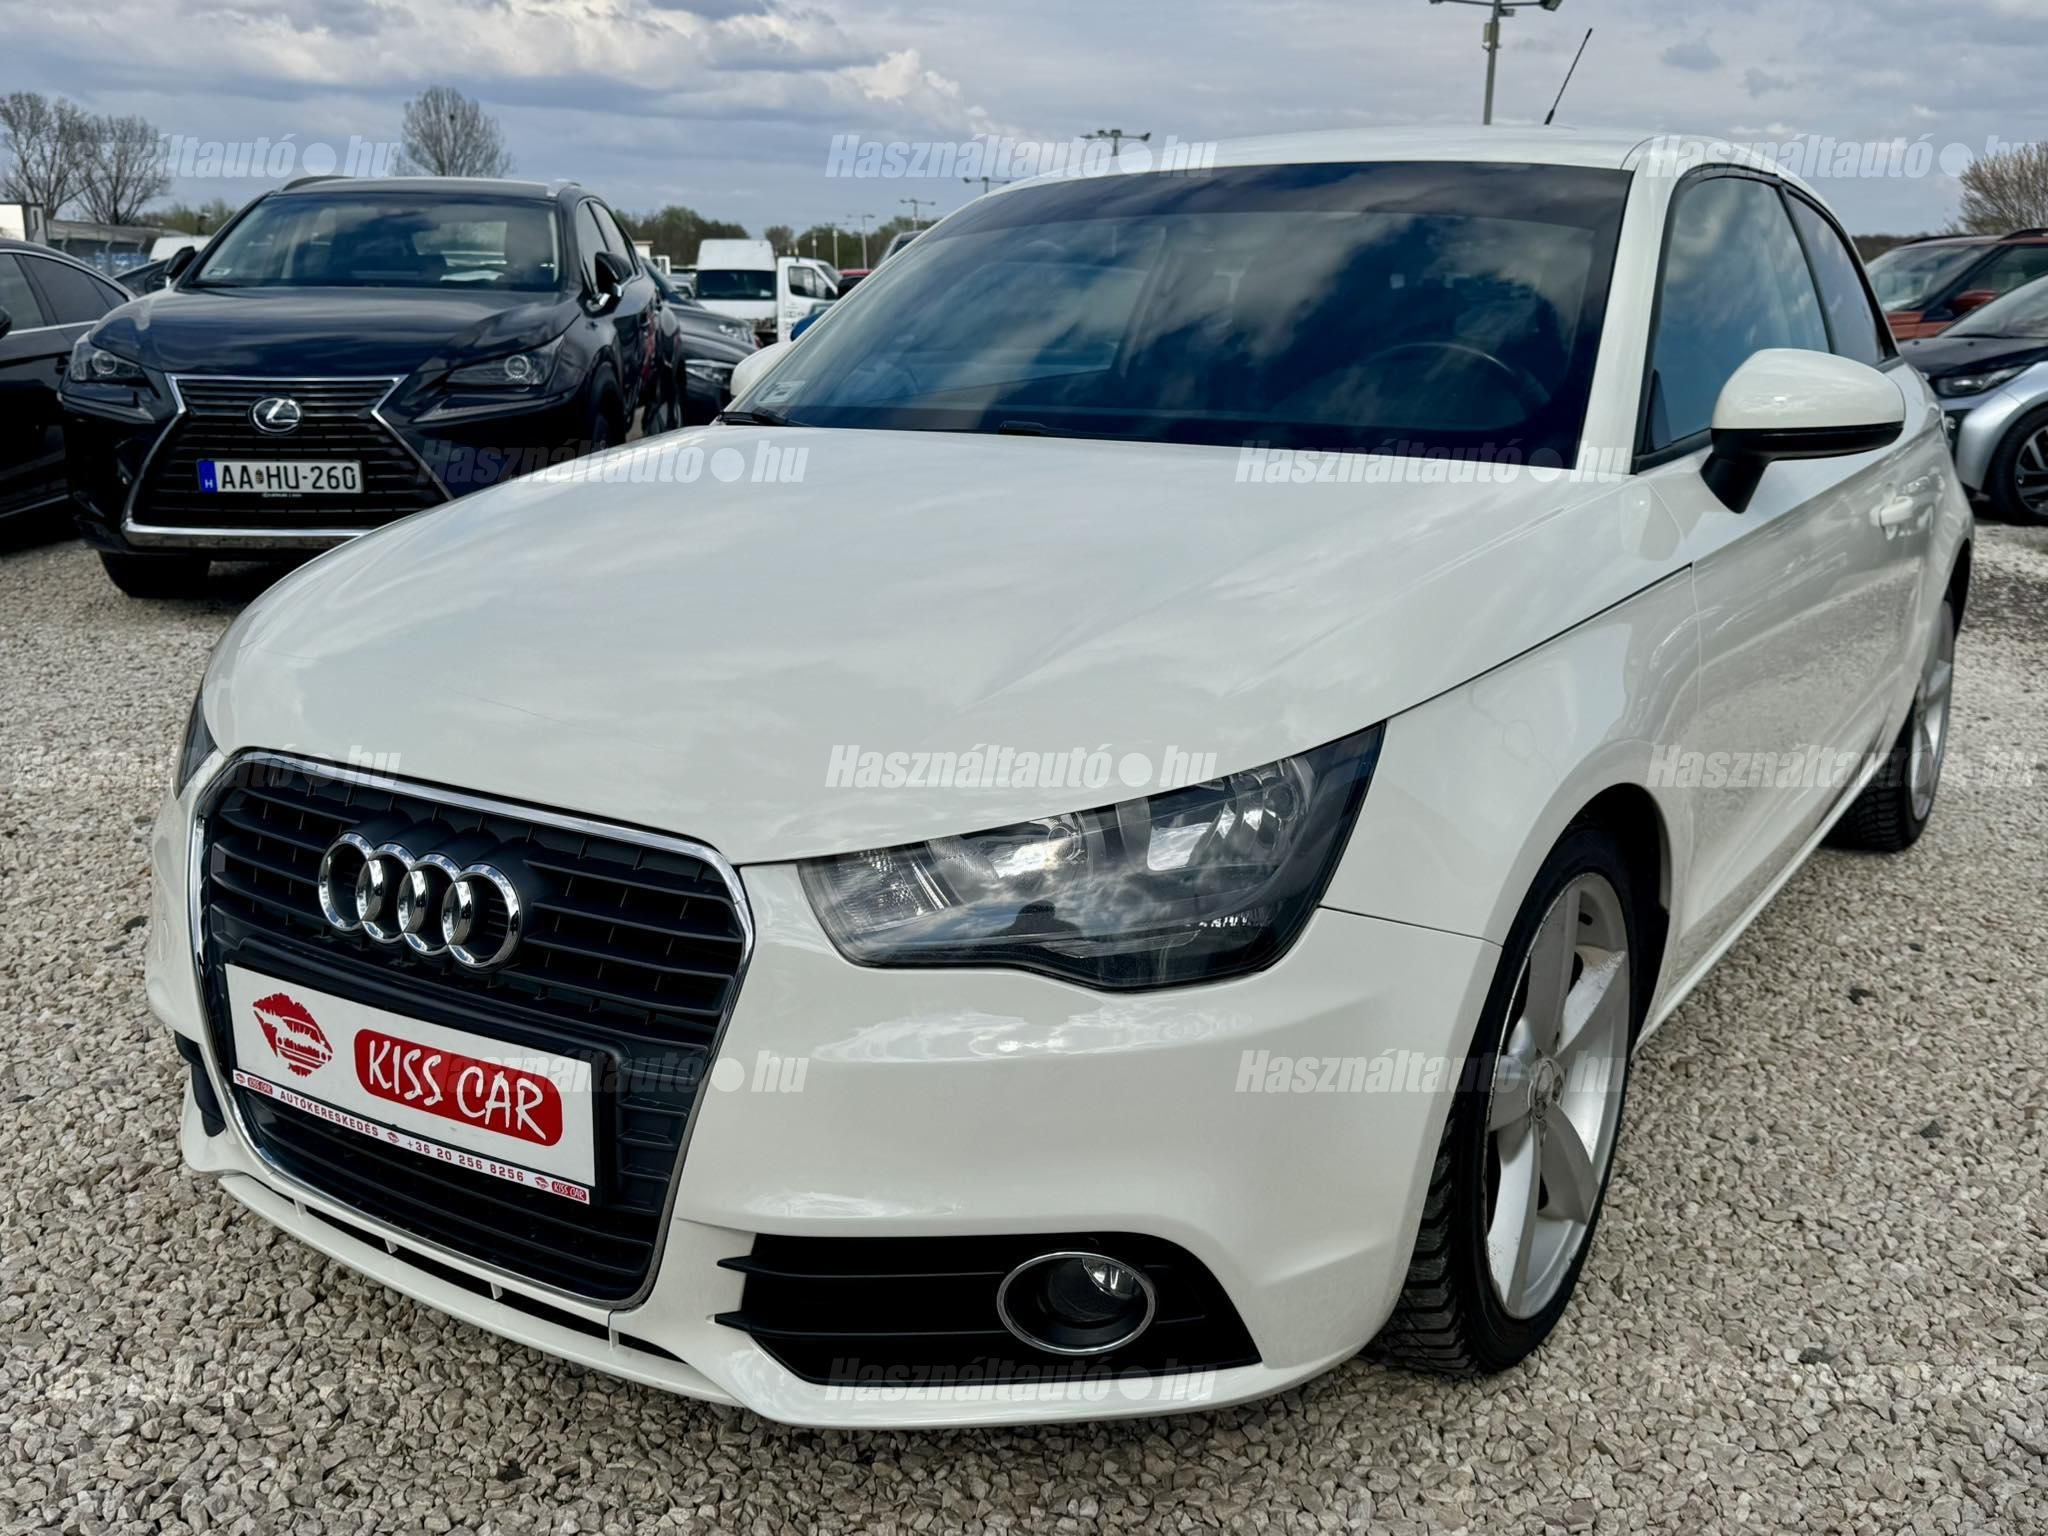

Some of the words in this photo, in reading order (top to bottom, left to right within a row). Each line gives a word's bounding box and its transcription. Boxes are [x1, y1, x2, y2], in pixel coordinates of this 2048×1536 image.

[369, 1039, 443, 1106] KISS
[456, 1066, 547, 1140] CAR
[407, 1140, 431, 1154] +36
[436, 1148, 452, 1161] 20
[458, 1154, 483, 1170] 256
[489, 1163, 524, 1182] 8256
[553, 1181, 569, 1195] KISS
